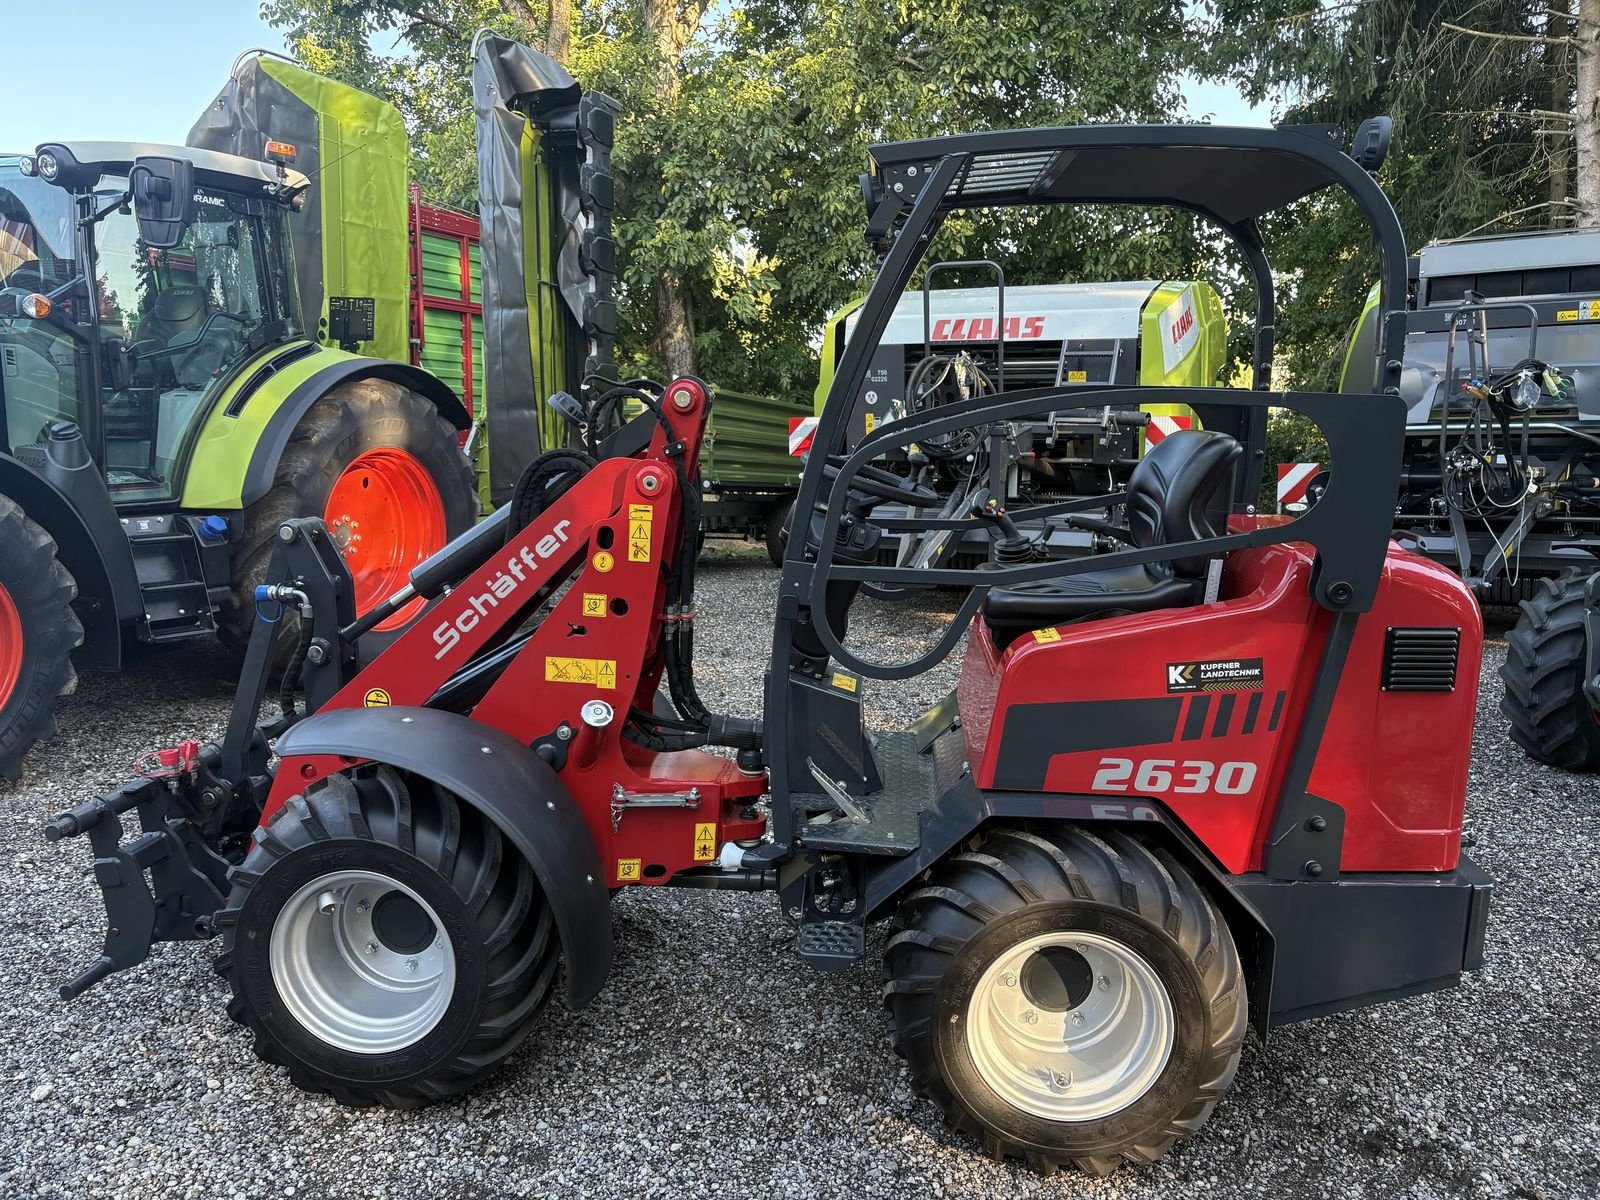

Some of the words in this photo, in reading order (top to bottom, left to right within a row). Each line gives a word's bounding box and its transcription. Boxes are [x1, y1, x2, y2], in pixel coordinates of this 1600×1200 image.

[931, 316, 1046, 340] CLAAS
[1171, 305, 1194, 345] CLAAS
[432, 519, 571, 661] Schäffer
[1200, 662, 1241, 671] KUPFNER
[1200, 668, 1261, 679] LANDTECHNIK
[1091, 757, 1258, 795] 2630
